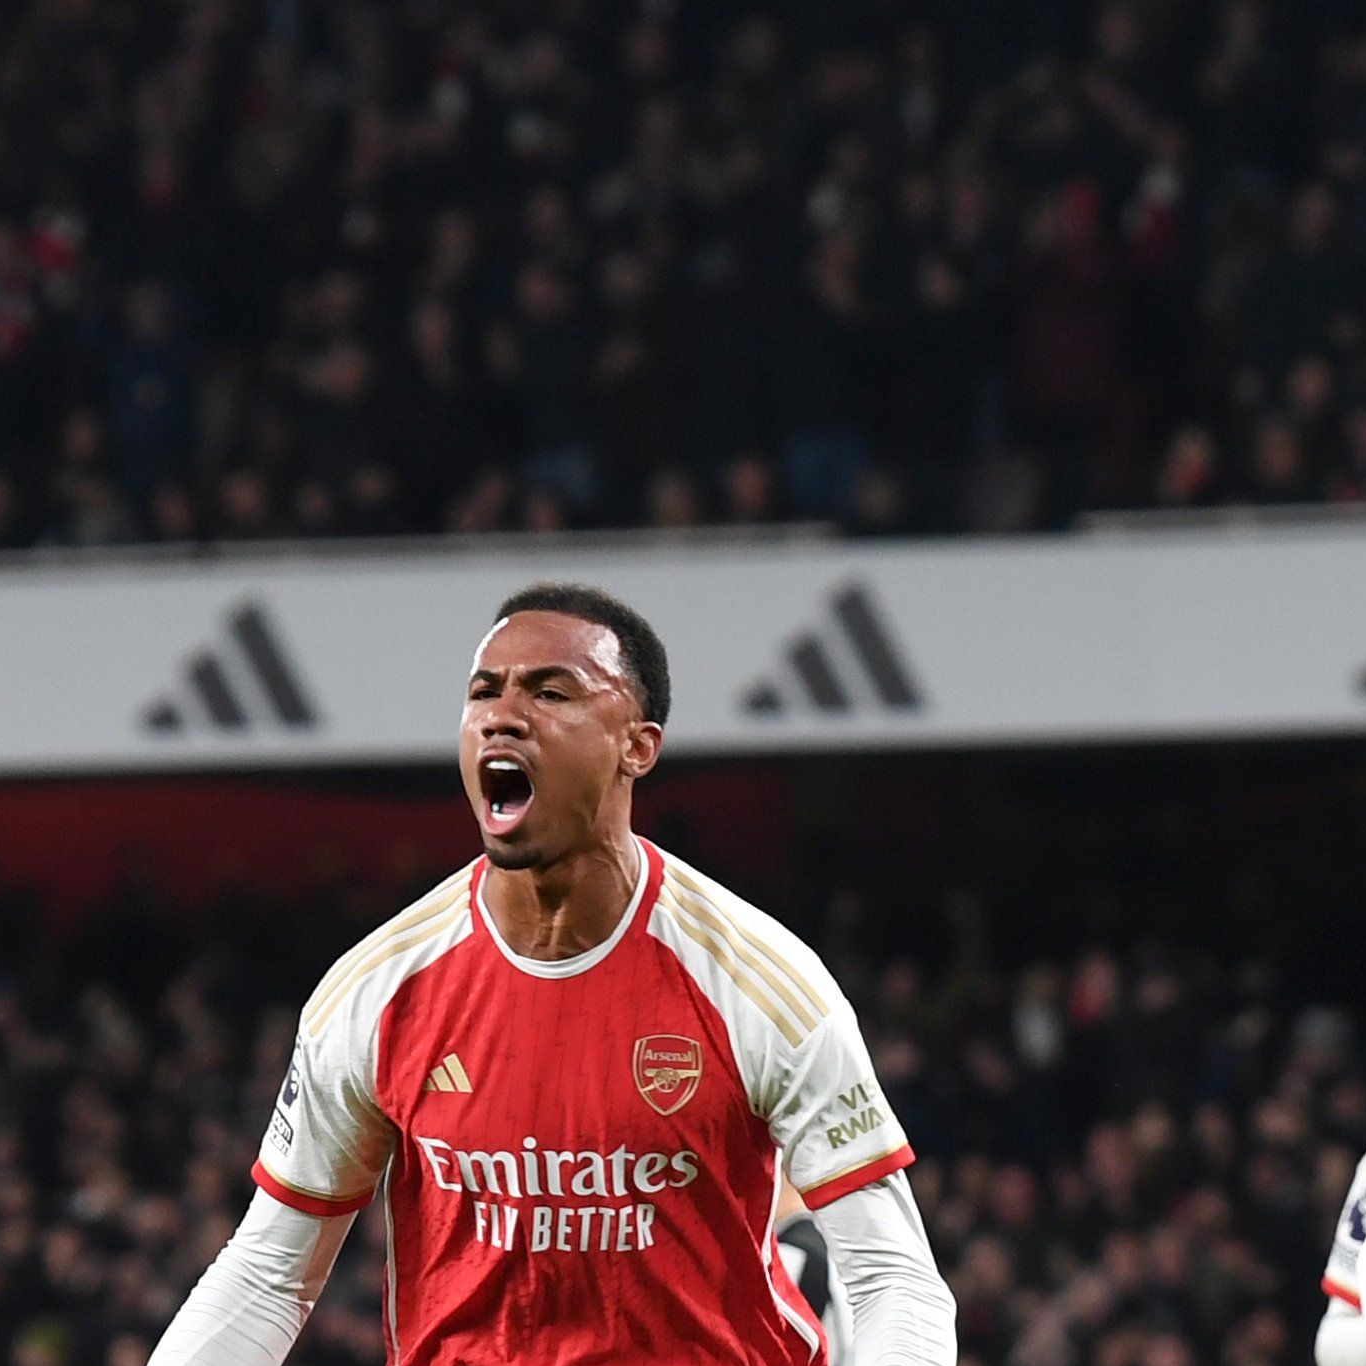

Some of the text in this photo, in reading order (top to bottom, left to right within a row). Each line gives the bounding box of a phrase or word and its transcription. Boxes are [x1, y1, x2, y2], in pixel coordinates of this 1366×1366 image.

[643, 1049, 693, 1062] Arsenal
[415, 1136, 699, 1198] Emirates
[473, 1201, 656, 1252] FLY BETTER
